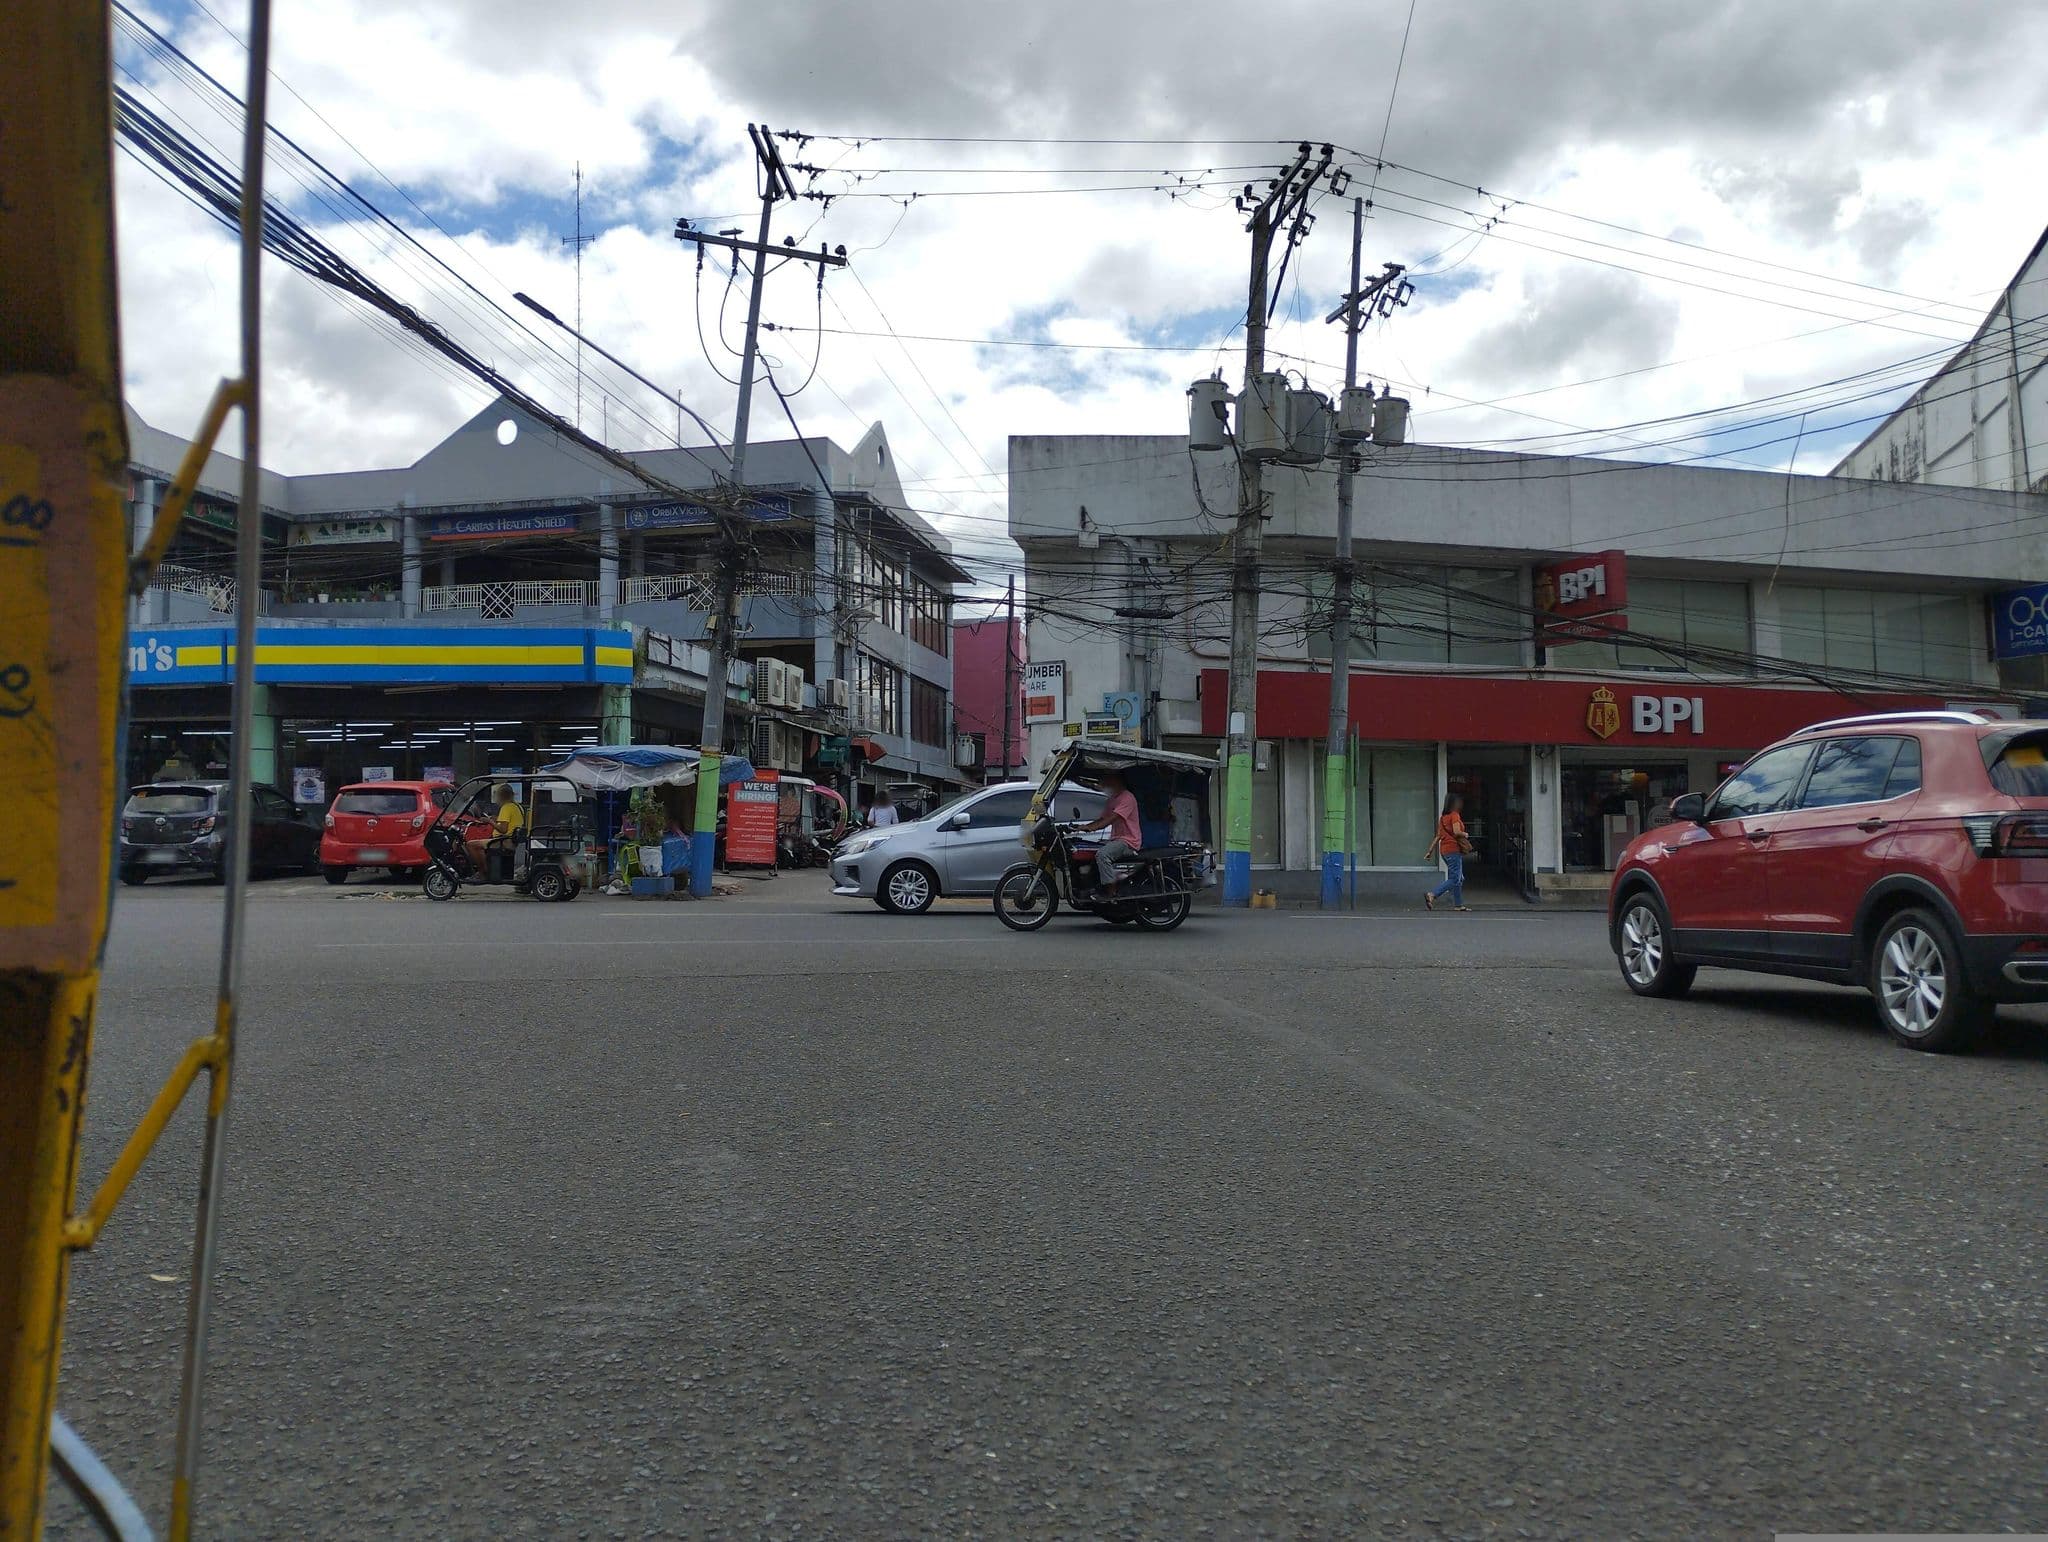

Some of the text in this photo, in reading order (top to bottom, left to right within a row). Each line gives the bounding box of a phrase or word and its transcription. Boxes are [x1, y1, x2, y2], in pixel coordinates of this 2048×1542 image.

[498, 518, 531, 530] HEALTH
[535, 516, 566, 529] SHIELD
[1559, 564, 1606, 604] BPI
[2009, 624, 2048, 641] I-CA
[128, 637, 173, 671] n's
[1632, 696, 1704, 734] BPI
[743, 782, 777, 791] WE'RE
[736, 791, 778, 802] HIRING!
